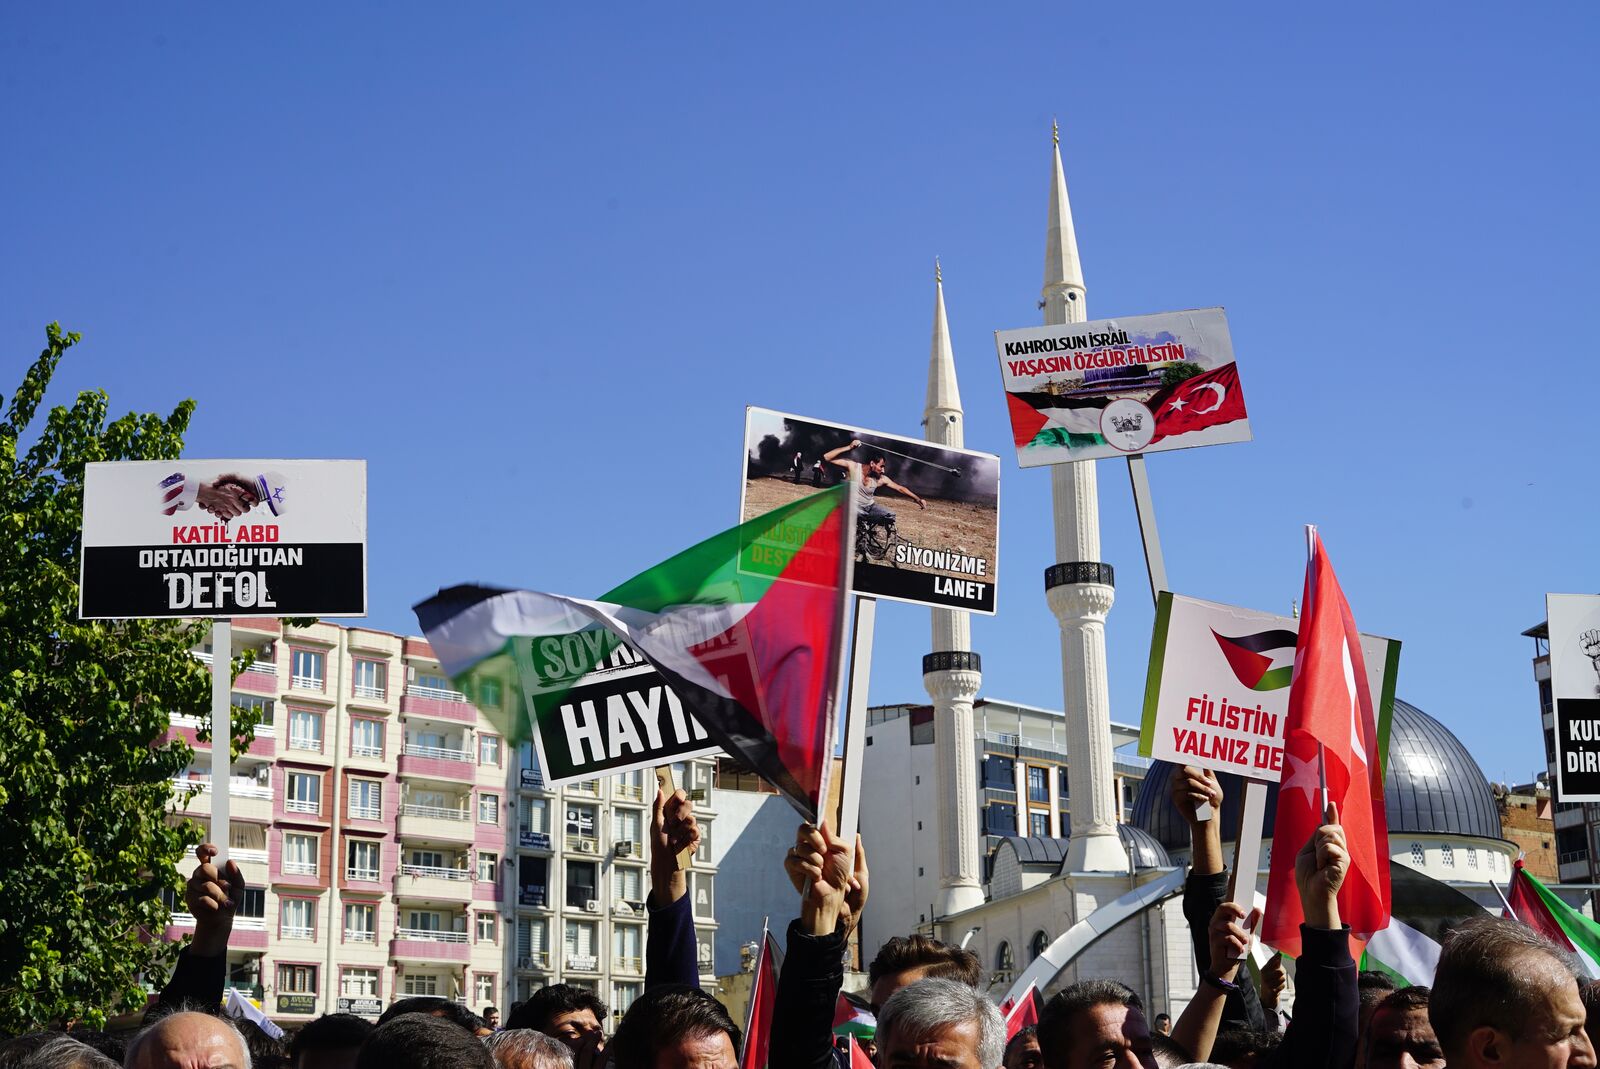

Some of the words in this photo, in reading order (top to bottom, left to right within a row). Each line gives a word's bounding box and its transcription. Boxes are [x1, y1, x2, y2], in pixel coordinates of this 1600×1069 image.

[1005, 335, 1087, 356] KAHROLSUN
[1089, 329, 1131, 347] İSRAİL
[1008, 356, 1072, 377] YAŞASIN
[1073, 349, 1126, 370] ÖZGÜR
[1127, 343, 1185, 364] FİLİSTİN
[173, 522, 231, 544] KATİL
[236, 524, 279, 543] ABD
[139, 544, 303, 568] ORTADOĞU'DAN
[896, 542, 986, 576] SİYONİZME
[166, 571, 276, 609] DEFOL
[934, 577, 985, 601] LANET
[1186, 694, 1277, 738] FİLİSTİN
[1172, 727, 1250, 765] YALNIZ
[1566, 745, 1600, 773] DİR
